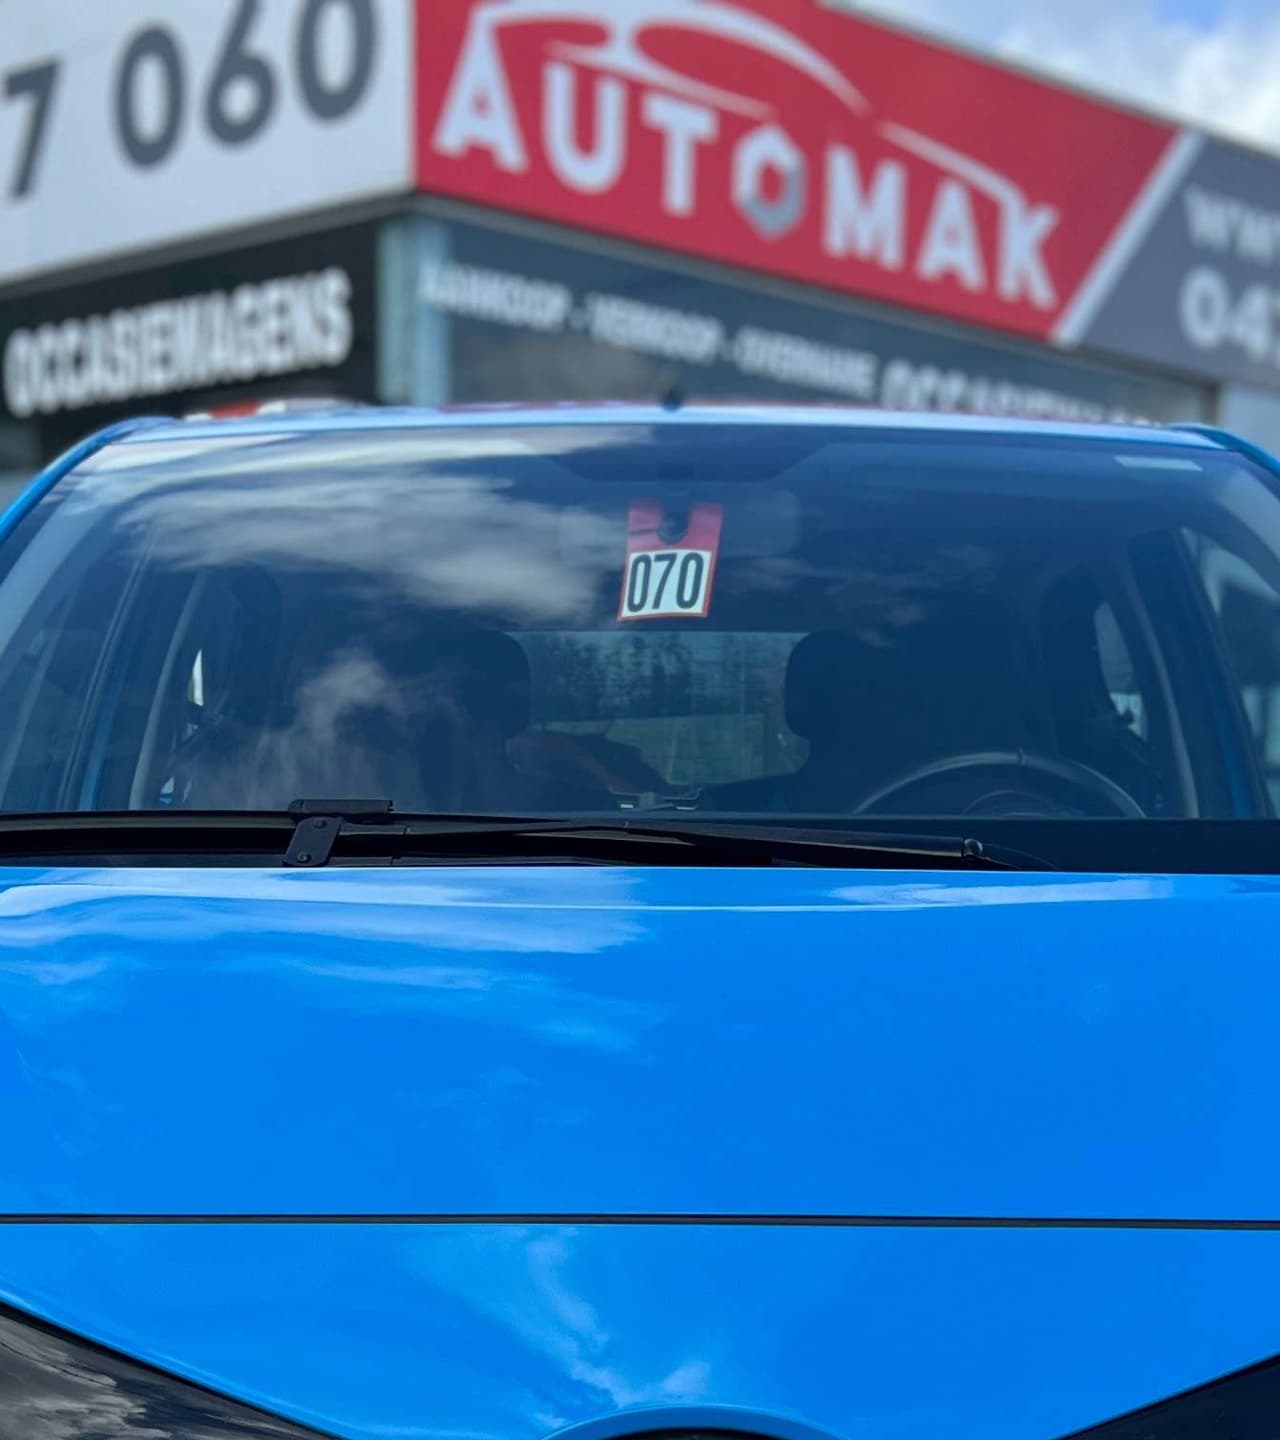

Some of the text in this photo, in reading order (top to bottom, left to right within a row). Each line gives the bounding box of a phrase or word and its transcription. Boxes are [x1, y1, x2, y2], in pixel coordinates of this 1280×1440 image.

[112, 0, 380, 170] 060
[432, 8, 1058, 309] AUTOMAK
[4, 265, 355, 419] OCCASIEWAGENS
[627, 552, 704, 613] 070
